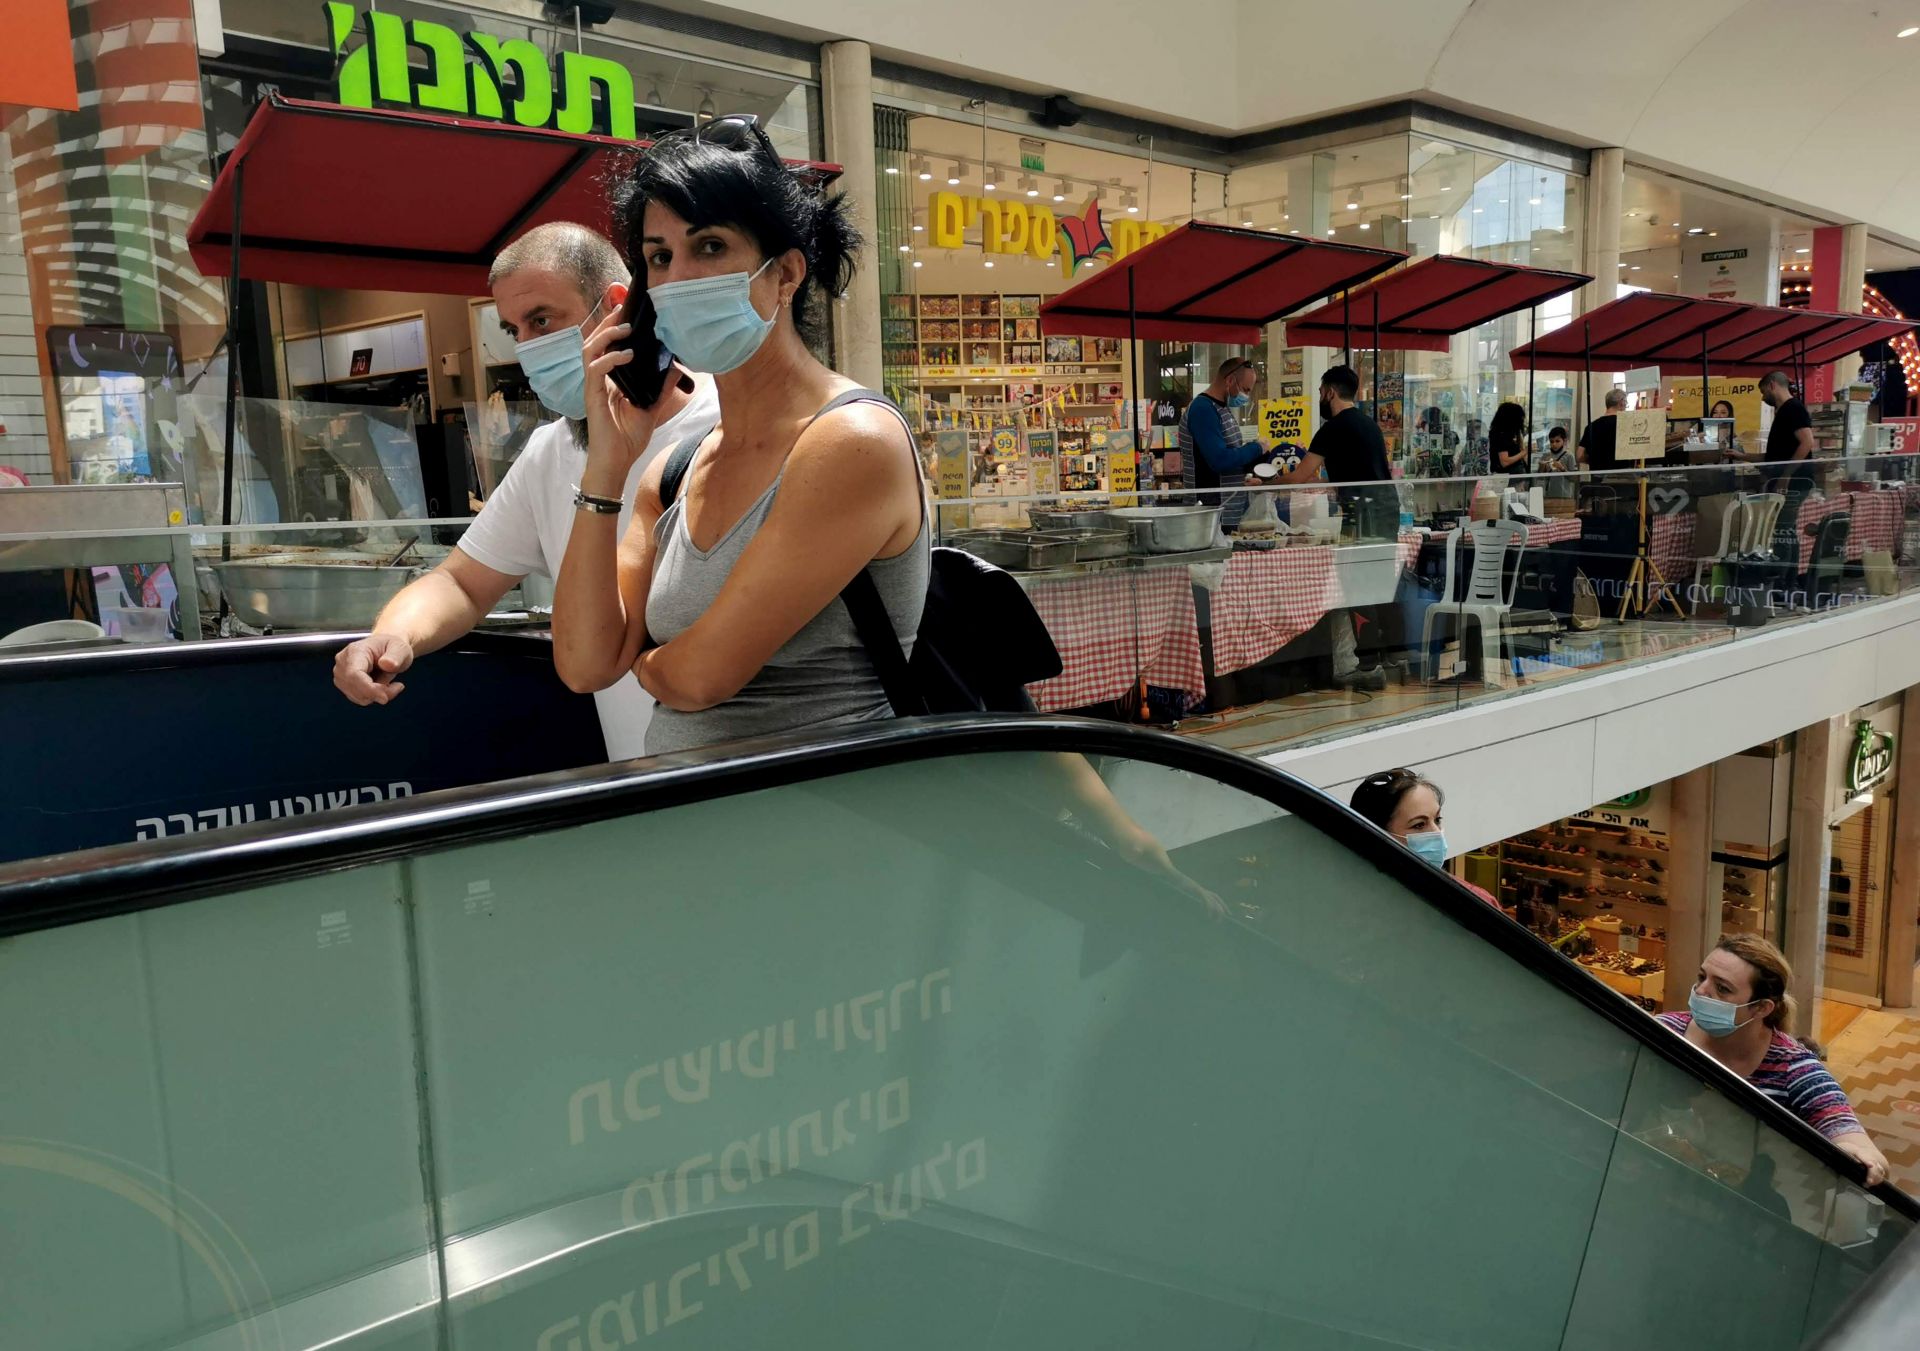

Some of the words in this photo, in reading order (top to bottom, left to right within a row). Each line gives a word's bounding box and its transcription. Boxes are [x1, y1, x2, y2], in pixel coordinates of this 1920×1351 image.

[929, 191, 1057, 260] ספרים
[1265, 408, 1303, 420] חגיגת
[1270, 418, 1299, 429] חודש
[1268, 428, 1301, 439] הספר
